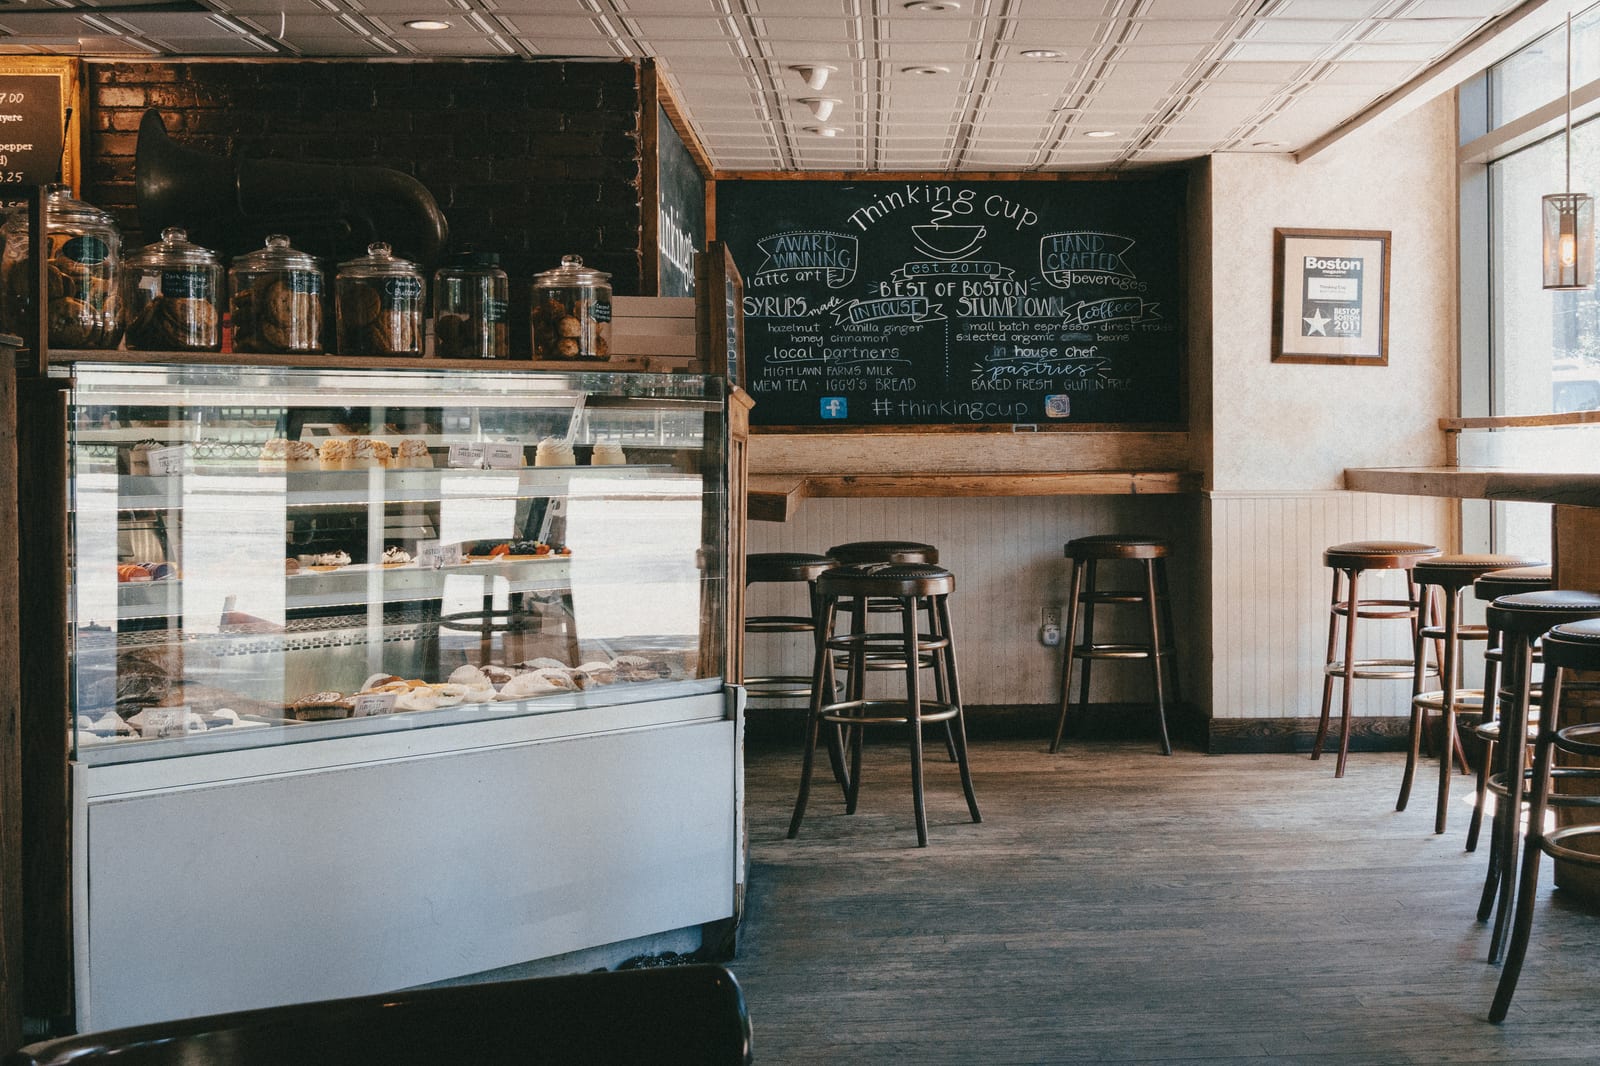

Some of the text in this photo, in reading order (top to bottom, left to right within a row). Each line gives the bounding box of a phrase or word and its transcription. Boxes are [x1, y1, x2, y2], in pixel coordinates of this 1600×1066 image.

[848, 184, 1038, 231] Thinking Cup
[775, 234, 837, 252] AWARD
[1053, 234, 1105, 252] HAND
[772, 250, 851, 268] WINNING
[1047, 253, 1119, 270] CRAFTED
[1305, 257, 1360, 270] Boston
[951, 263, 992, 274] 2010
[746, 270, 822, 288] latte art
[1072, 272, 1148, 292] beverages
[880, 280, 1028, 297] BEST OF BOSTON
[742, 296, 807, 318] SYRUPS
[806, 296, 844, 317] made
[872, 299, 921, 317] HOUSE
[956, 297, 1139, 320] STUMPTOWN coffee
[1334, 307, 1350, 315] BEST
[768, 322, 924, 336] hazelnut vanilla ginger
[999, 321, 1029, 332] batch
[1033, 322, 1090, 335] espresso
[1100, 322, 1136, 332] direct
[1334, 321, 1360, 331] 2011
[791, 335, 889, 347] honey cinnamon
[1011, 332, 1055, 345] organic
[1096, 332, 1130, 342] beans
[773, 347, 900, 363] local partners
[1014, 345, 1059, 357] house
[764, 366, 893, 377] HIGH LAWN FARMS MILK
[986, 361, 1095, 380] pastries
[753, 380, 782, 392] MEM
[786, 380, 807, 391] TEA
[876, 378, 917, 391] BREAD
[971, 378, 1012, 391] BAKED
[1016, 378, 1053, 390] FRESH
